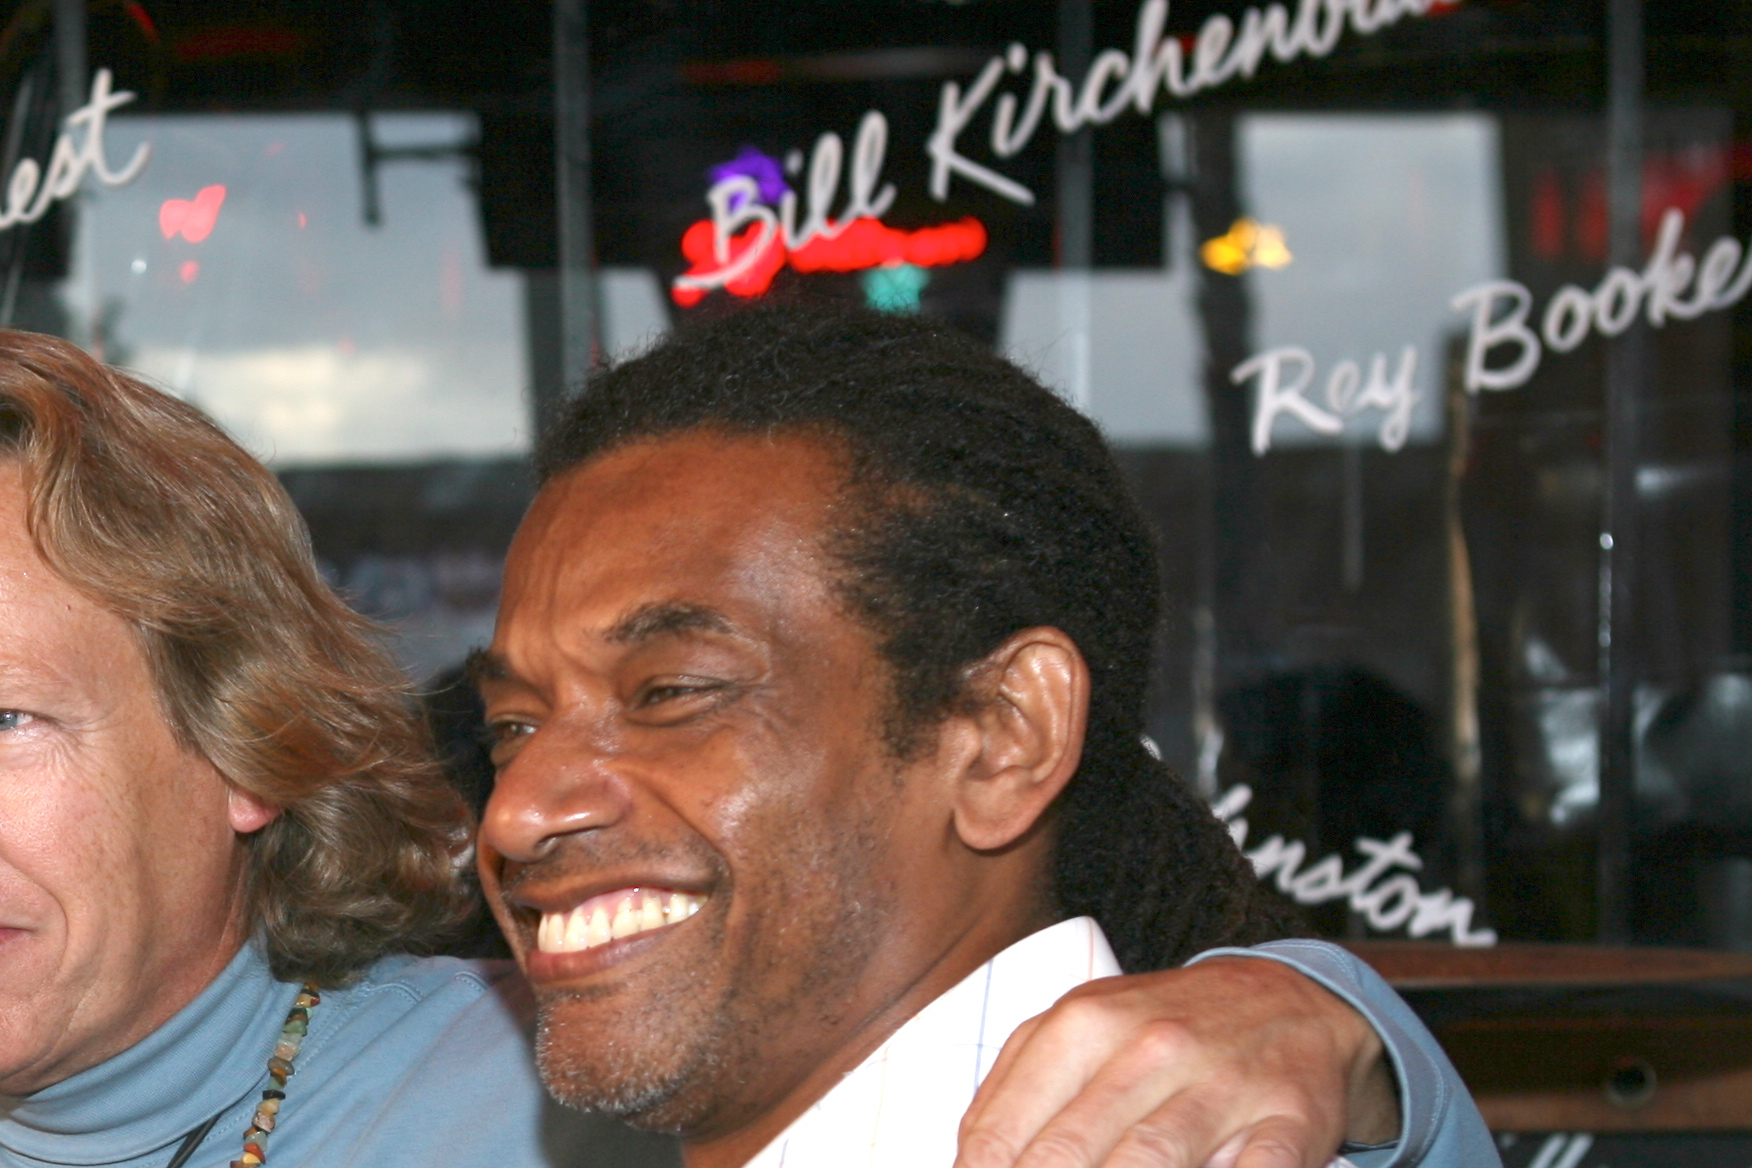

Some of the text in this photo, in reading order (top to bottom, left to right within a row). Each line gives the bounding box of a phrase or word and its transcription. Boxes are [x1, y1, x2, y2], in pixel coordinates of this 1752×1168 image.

[672, 109, 898, 290] Bill
[1454, 206, 1752, 394] Booke
[1141, 735, 1498, 948] inston
